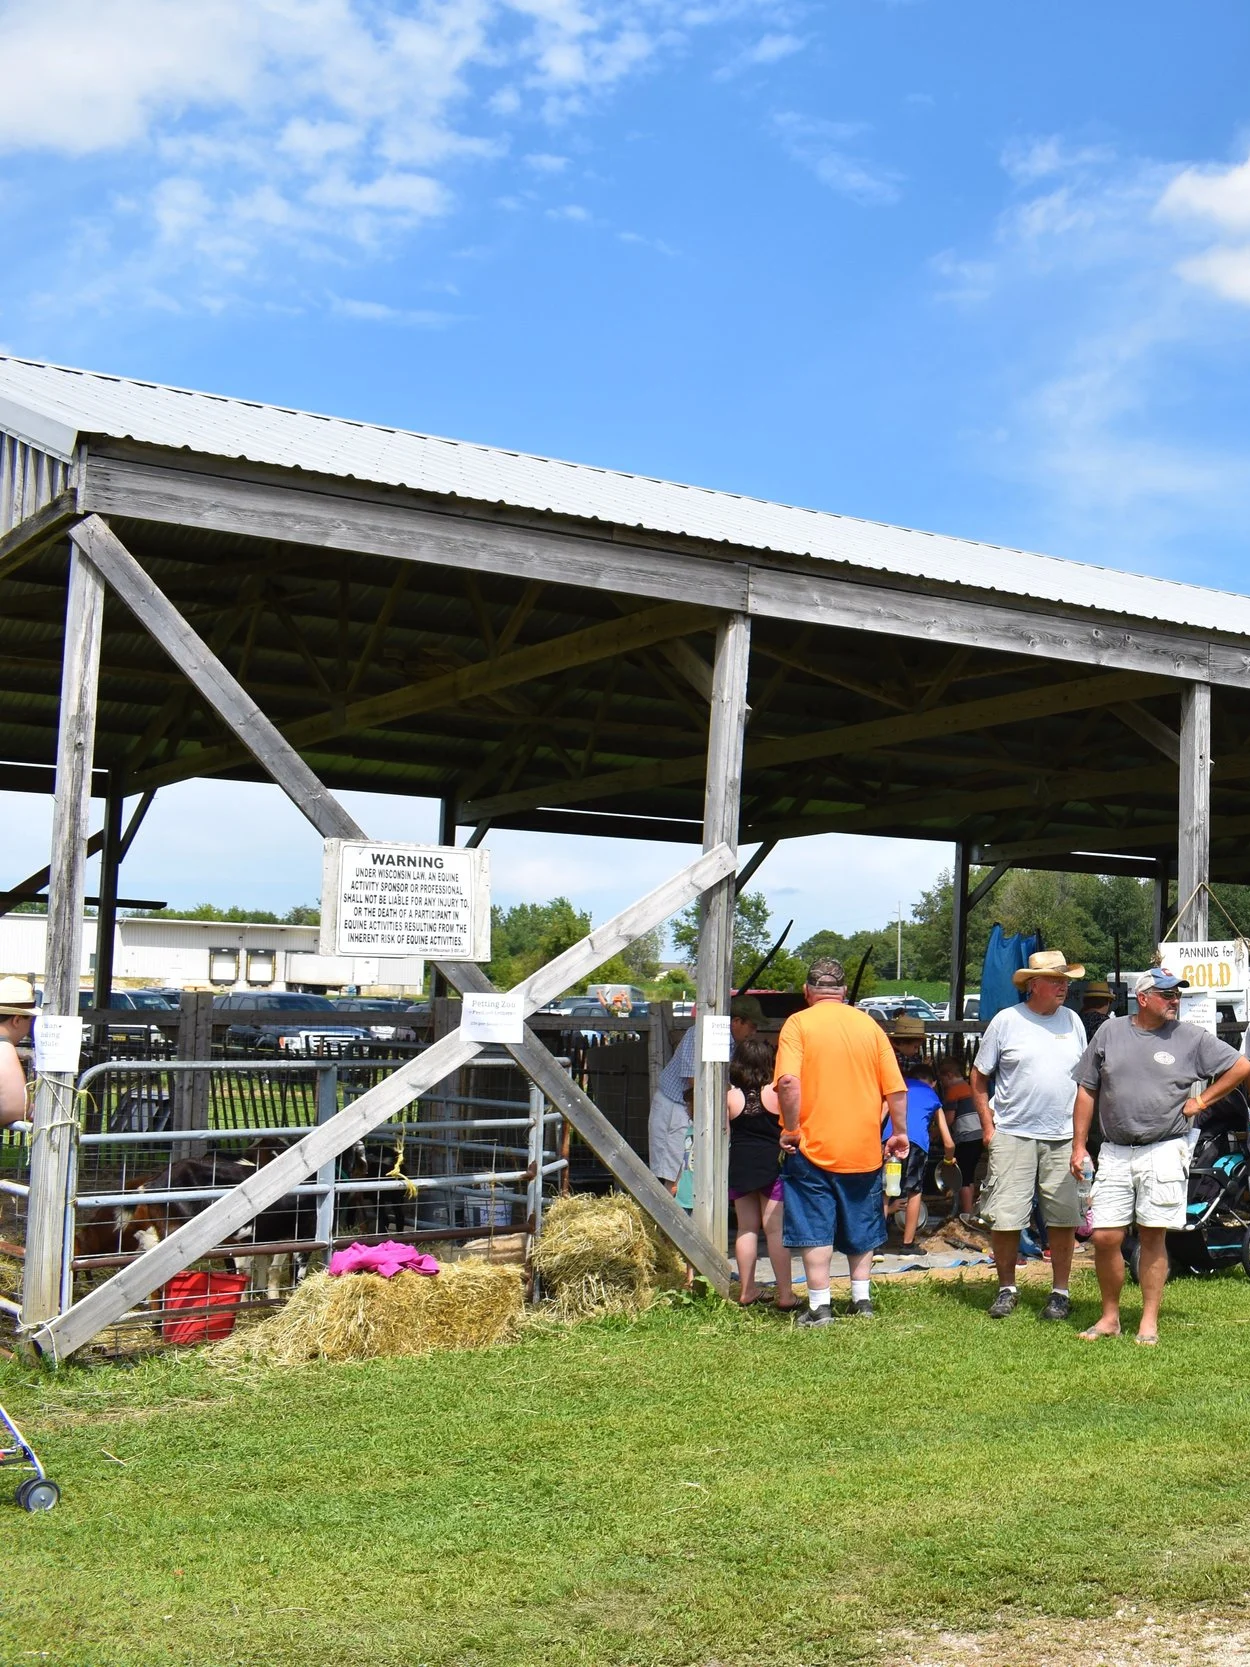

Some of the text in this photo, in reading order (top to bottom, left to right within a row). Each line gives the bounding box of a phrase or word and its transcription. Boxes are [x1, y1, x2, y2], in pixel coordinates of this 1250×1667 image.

[372, 853, 444, 868] WARNING
[356, 868, 376, 878] UNDER
[378, 869, 411, 879] WISCONSIN
[428, 872, 436, 881] AN
[438, 873, 459, 882] EQUINE
[351, 881, 463, 895] ACTIVITY SPONSOR OR PROFESSIONAL
[344, 893, 362, 903] SHALL
[365, 895, 377, 904] NOT
[379, 895, 386, 904] BE
[389, 896, 408, 905] LIABLE
[411, 897, 422, 905] FOR
[424, 897, 435, 906] ANY
[438, 898, 458, 907] INJURY
[354, 907, 459, 920] OR THE DEATH OF A PARTICIPANT IN
[344, 920, 467, 933] EQUINE ACTIVITIES RESULTING FROM THE
[348, 933, 378, 943] INHERENT
[381, 934, 395, 943] RISK
[397, 934, 404, 944] OF
[406, 935, 428, 944] EQUINE
[1180, 946, 1233, 958] PANNING for
[1182, 962, 1231, 988] GOLD
